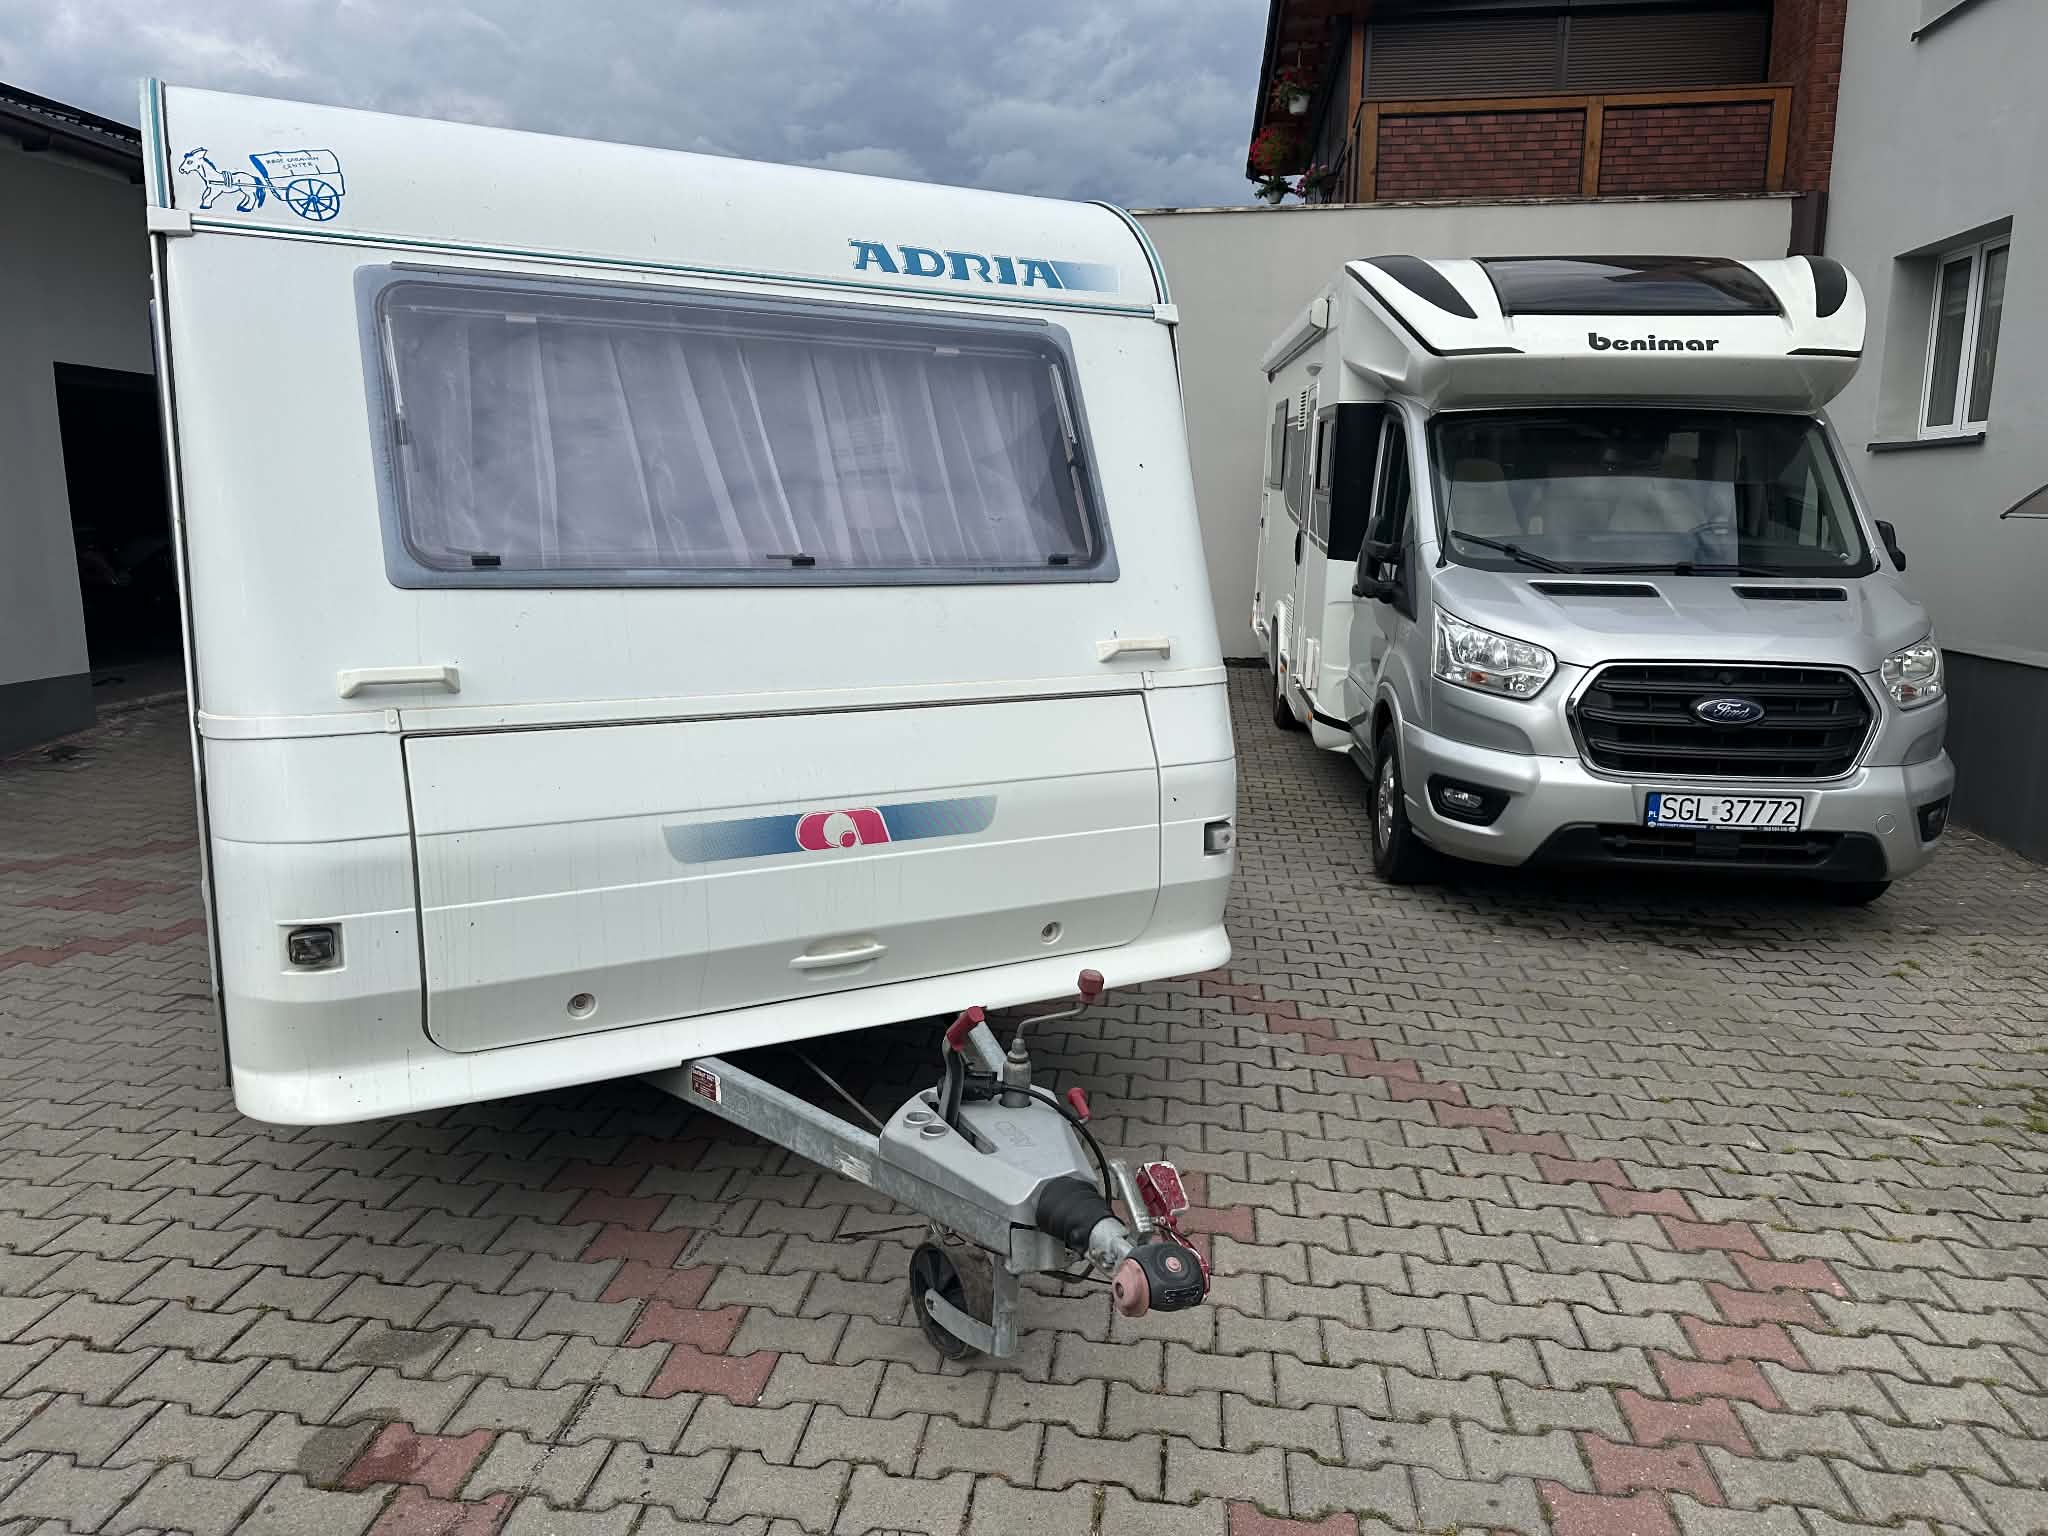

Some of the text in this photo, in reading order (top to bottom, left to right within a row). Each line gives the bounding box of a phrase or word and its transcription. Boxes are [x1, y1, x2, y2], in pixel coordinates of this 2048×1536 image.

[849, 239, 1064, 289] ADRIA
[1587, 331, 1719, 350] benimar
[1713, 702, 1751, 718] Ford
[1647, 810, 1658, 818] PL
[1661, 796, 1797, 825] SGL 37772
